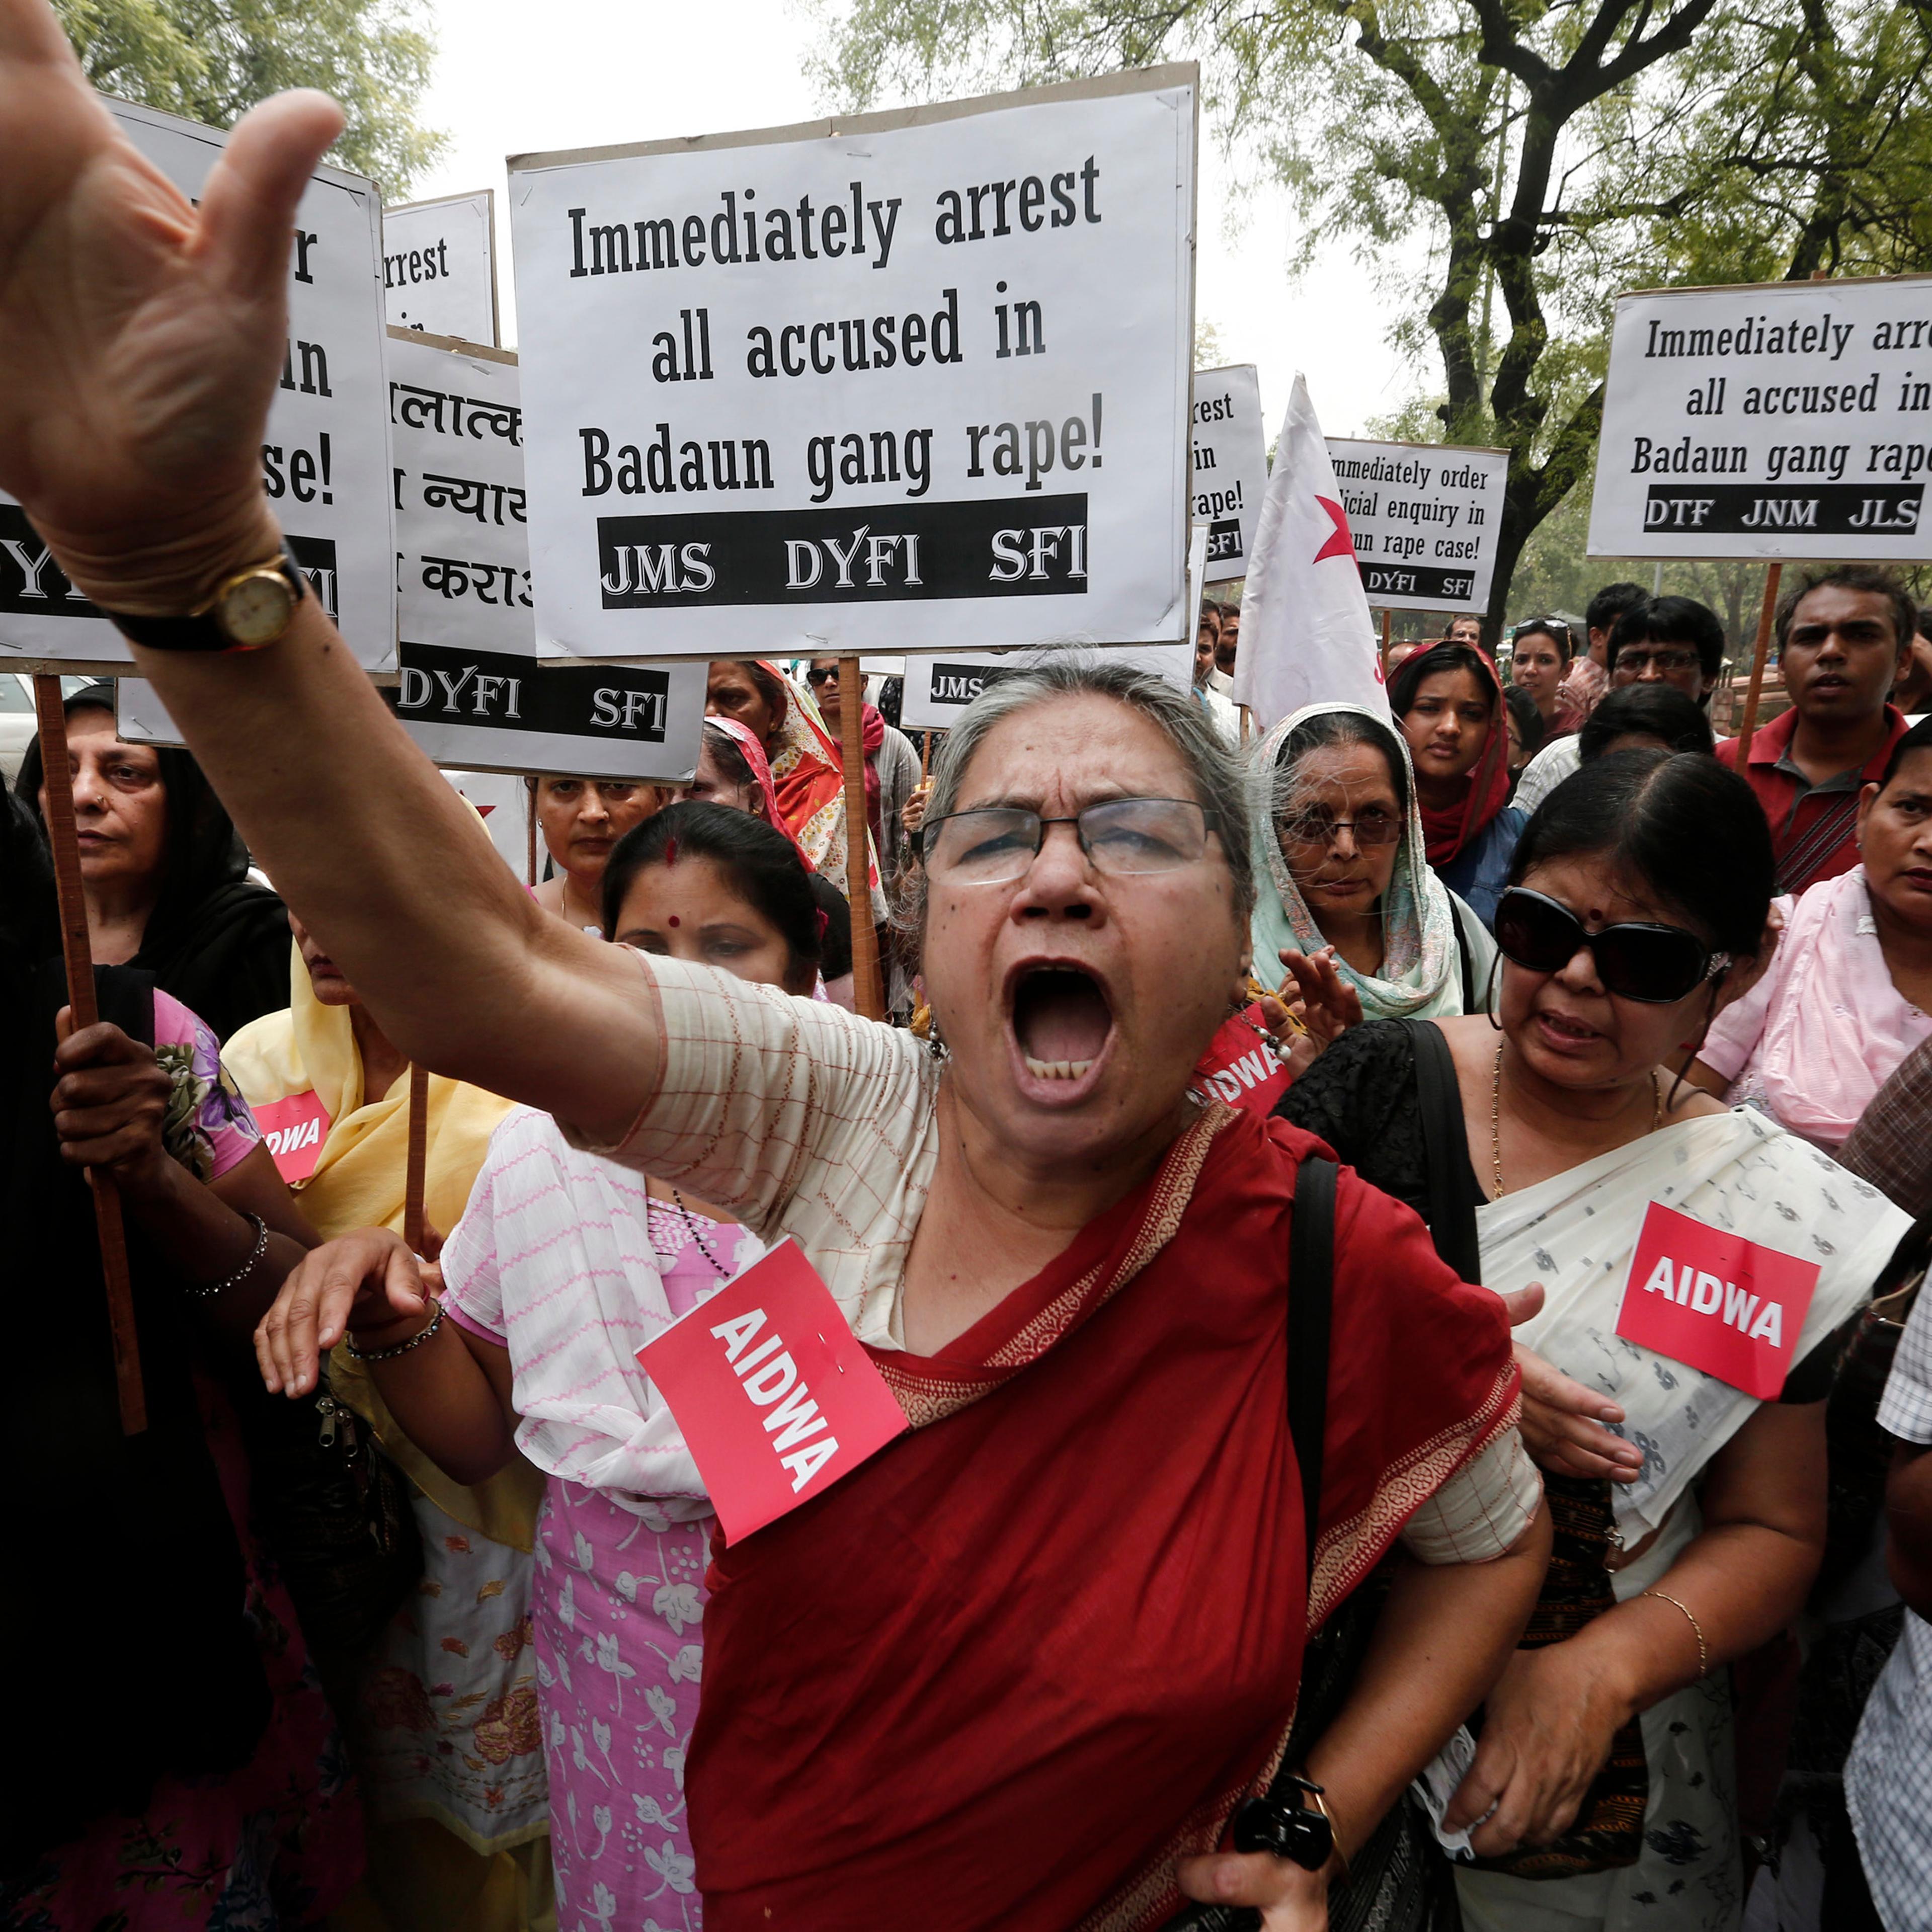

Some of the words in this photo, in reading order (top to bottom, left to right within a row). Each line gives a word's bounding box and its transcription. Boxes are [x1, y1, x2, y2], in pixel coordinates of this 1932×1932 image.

[569, 182, 902, 277] Immediately
[936, 155, 1101, 245] arrest
[653, 308, 713, 382] all
[748, 288, 962, 378] accused
[995, 281, 1045, 358] in
[1645, 314, 1854, 360] Immediately
[1873, 320, 1932, 350] arr
[1686, 378, 1726, 415] all
[1743, 373, 1879, 414] accused
[1898, 372, 1930, 411] in
[579, 423, 774, 496] Badaun
[807, 429, 933, 503] gang
[967, 393, 1101, 491] rape!
[1194, 441, 1216, 470] in
[1631, 437, 1746, 473] Badaun
[1766, 446, 1850, 480] gang
[1441, 465, 1488, 490] order
[1388, 498, 1459, 527] enquiry
[1468, 501, 1484, 525] in
[1645, 500, 1715, 526] DTF
[1741, 500, 1819, 526] JNM
[1848, 499, 1919, 527] JLS
[601, 542, 715, 595] JMS
[784, 525, 923, 589] DYFI
[989, 525, 1086, 581] SFI
[1384, 536, 1424, 559] rape
[1435, 536, 1480, 559] case!
[1369, 571, 1416, 592] DYFI
[1441, 578, 1473, 596] SFI
[397, 665, 521, 718] DYFI
[590, 688, 666, 732] SFI
[931, 676, 984, 699] JMS
[1643, 1256, 1783, 1348] AIDWA
[709, 1308, 839, 1494] AIDWA
